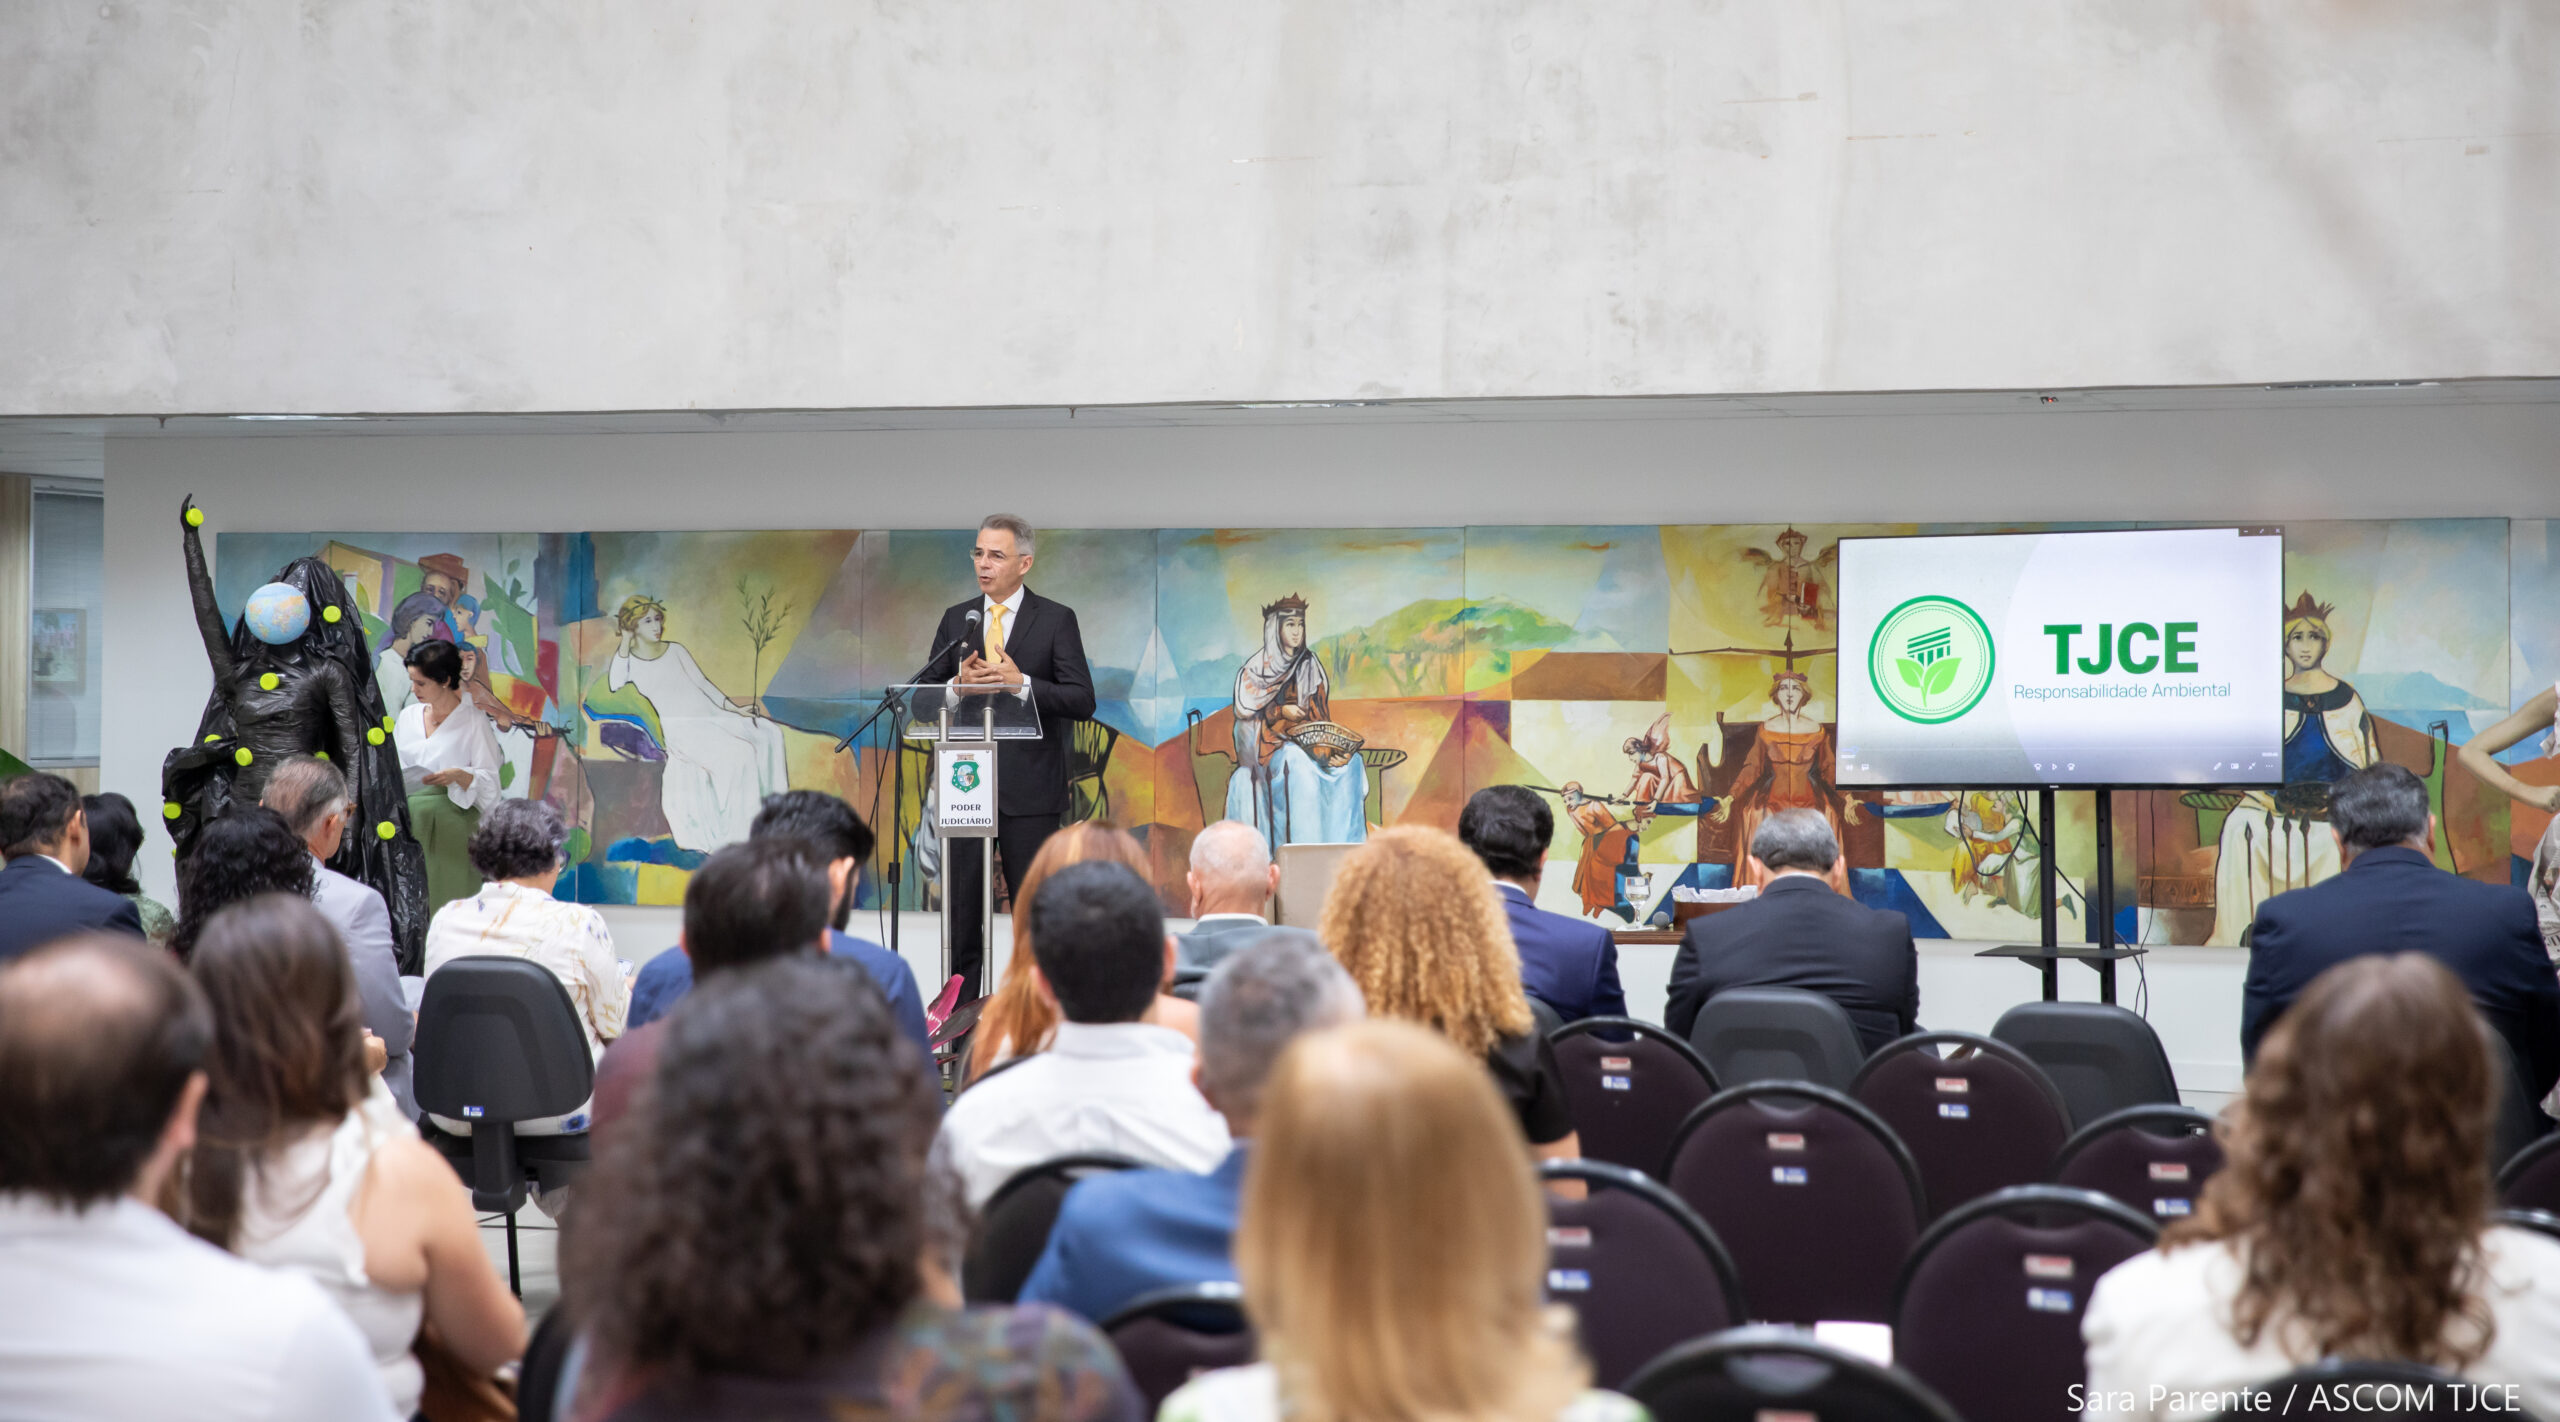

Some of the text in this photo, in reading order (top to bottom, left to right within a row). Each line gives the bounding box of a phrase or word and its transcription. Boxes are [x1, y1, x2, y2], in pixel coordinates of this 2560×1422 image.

[2043, 621, 2199, 675] TJCE
[2014, 682, 2231, 702] Responsabilidade Ambiental
[941, 816, 992, 825] JUDICIÁRIO
